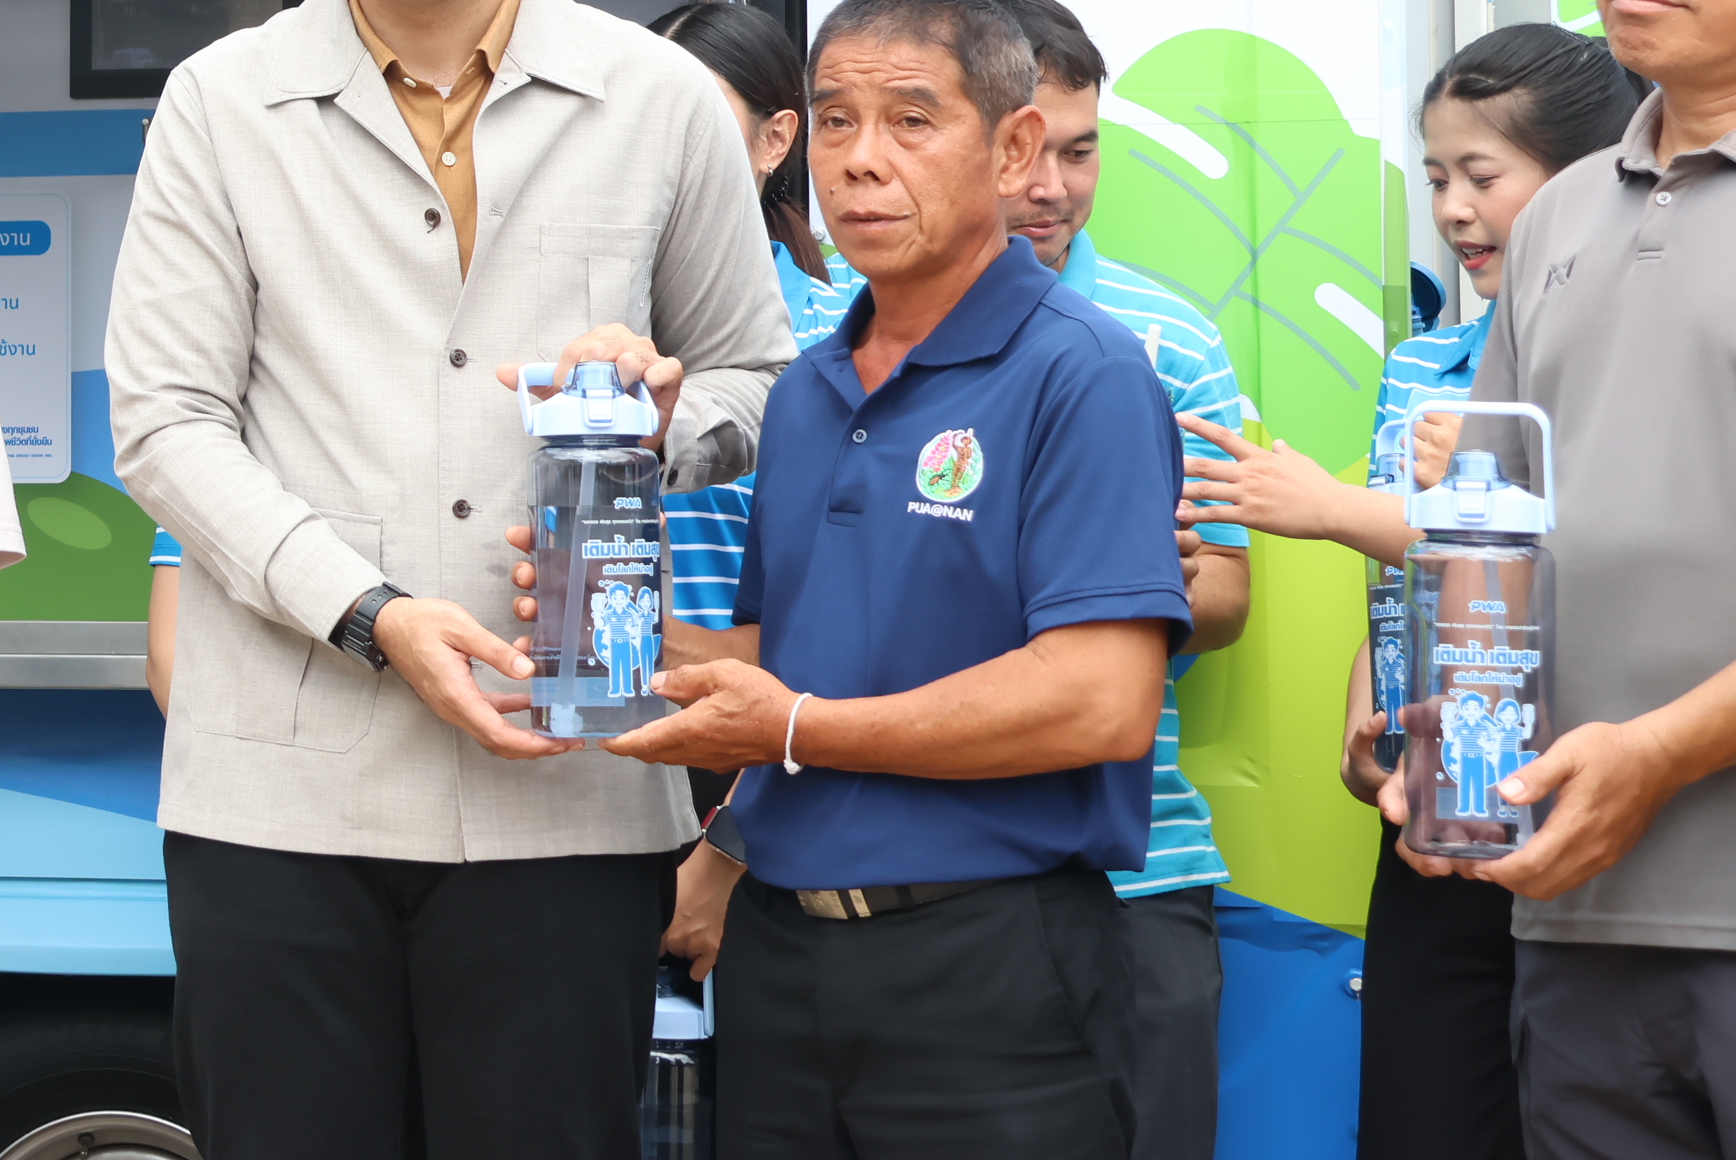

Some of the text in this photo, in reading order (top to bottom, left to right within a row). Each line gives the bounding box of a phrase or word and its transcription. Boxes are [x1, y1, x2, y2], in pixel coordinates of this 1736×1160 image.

[613, 497, 642, 509] PWA
[907, 501, 974, 522] PUA@NAN
[582, 534, 630, 559] เติมน้ำ
[1468, 600, 1506, 613] PWA
[1433, 640, 1542, 672] เติมน้ำ เติมสุข
